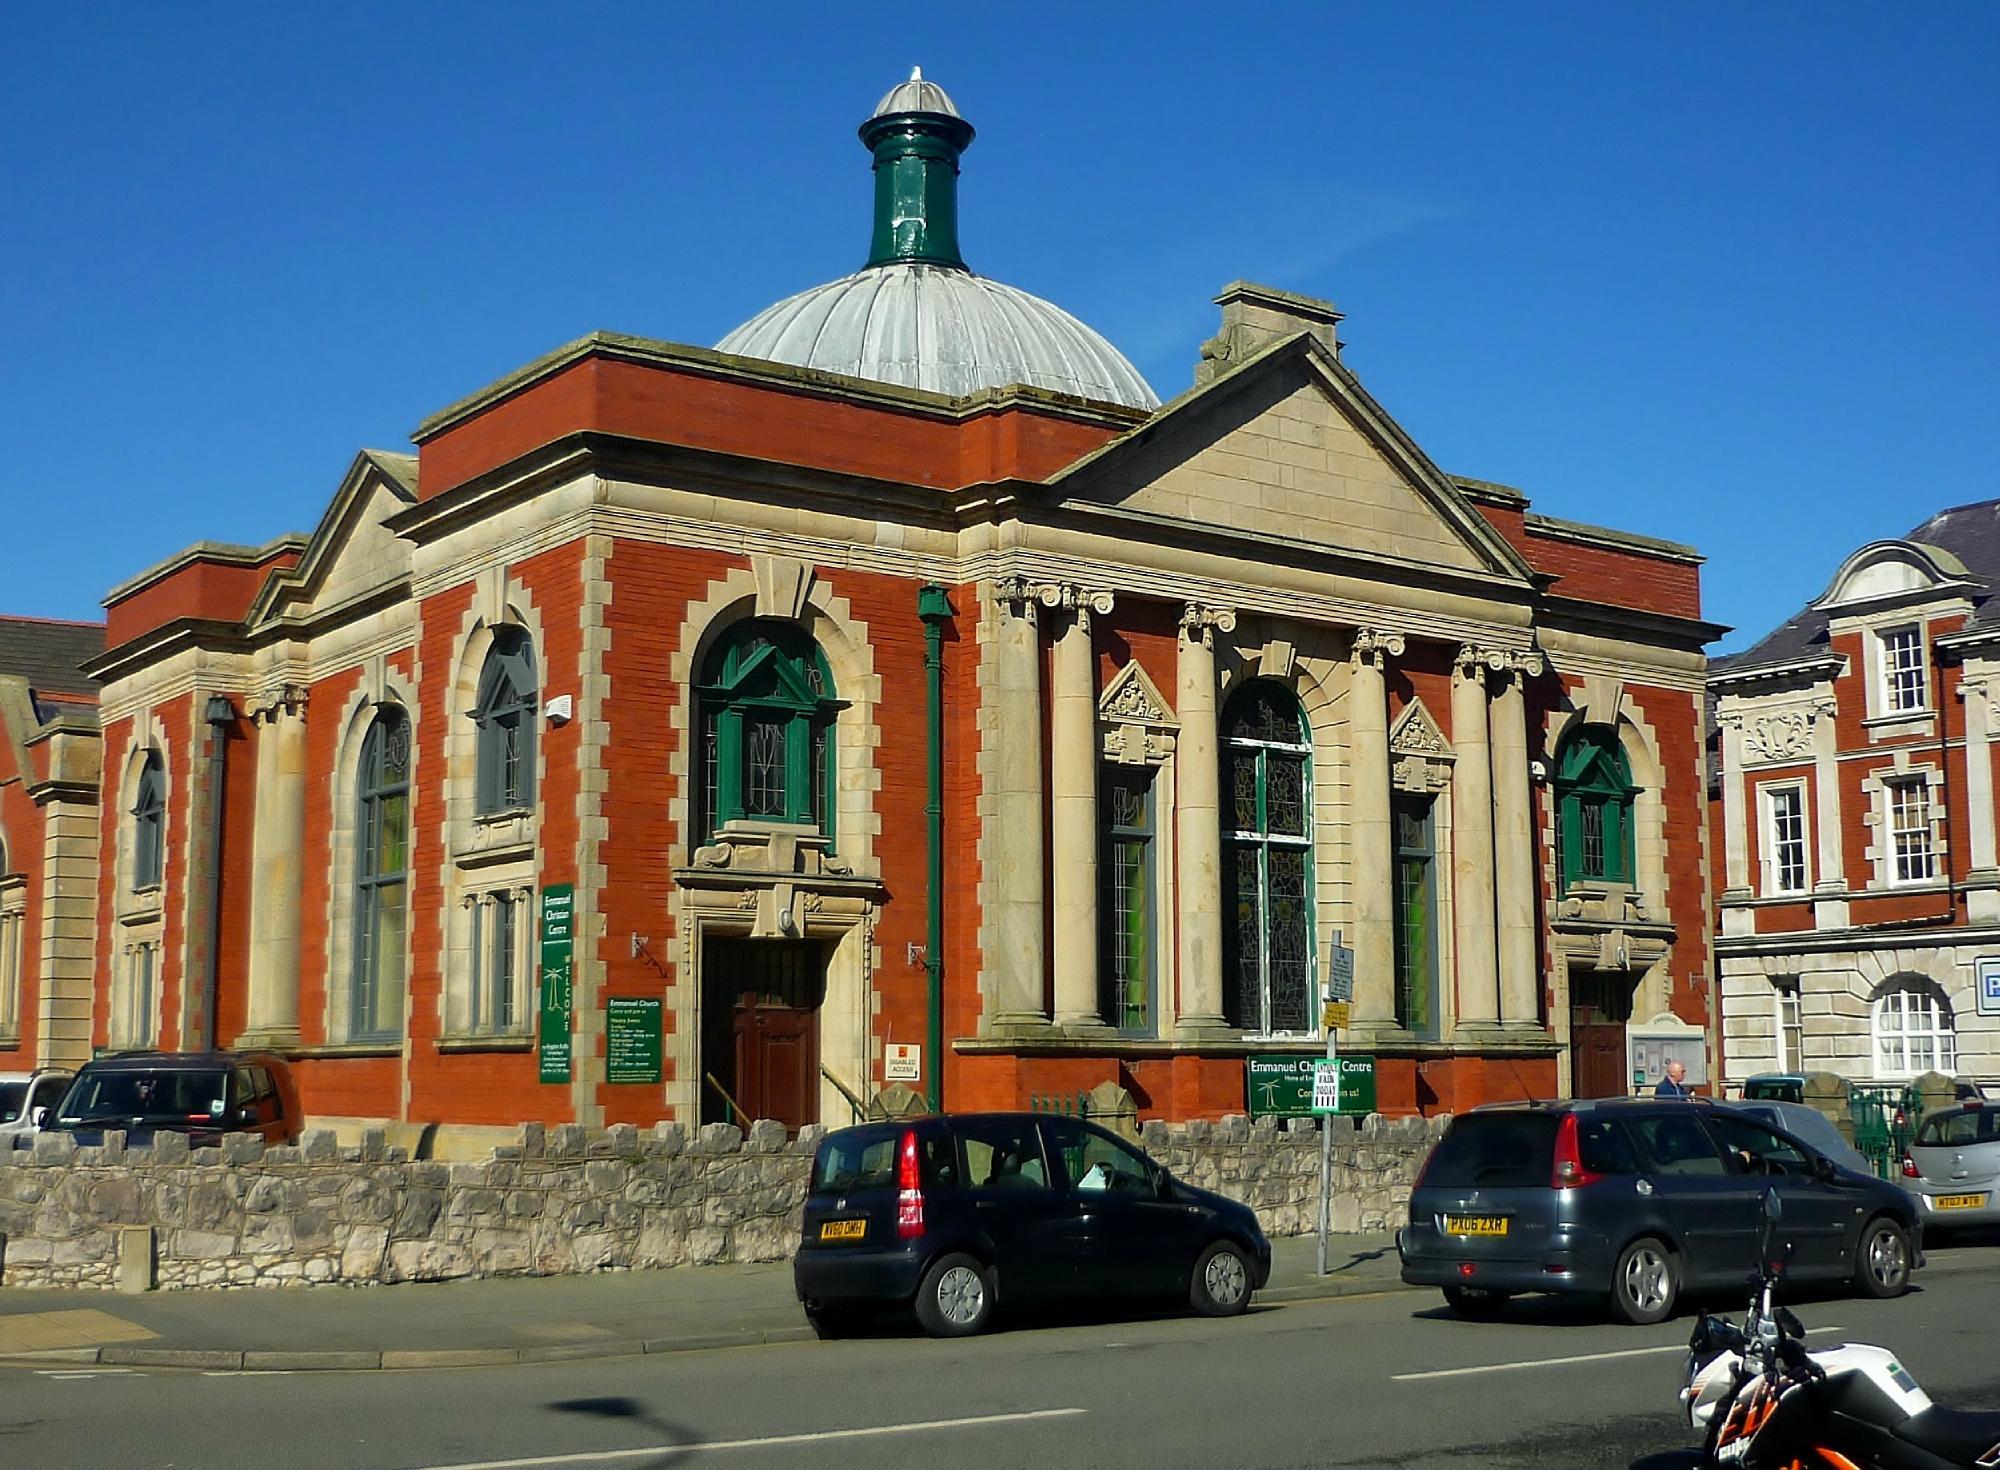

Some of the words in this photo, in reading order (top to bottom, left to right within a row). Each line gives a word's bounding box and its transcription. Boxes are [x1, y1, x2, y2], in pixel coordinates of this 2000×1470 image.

[1251, 1060, 1297, 1072] Emmanuel
[1342, 1060, 1372, 1072] Centre
[1451, 1217, 1478, 1231] PX06
[1480, 1217, 1503, 1231] ZXR
